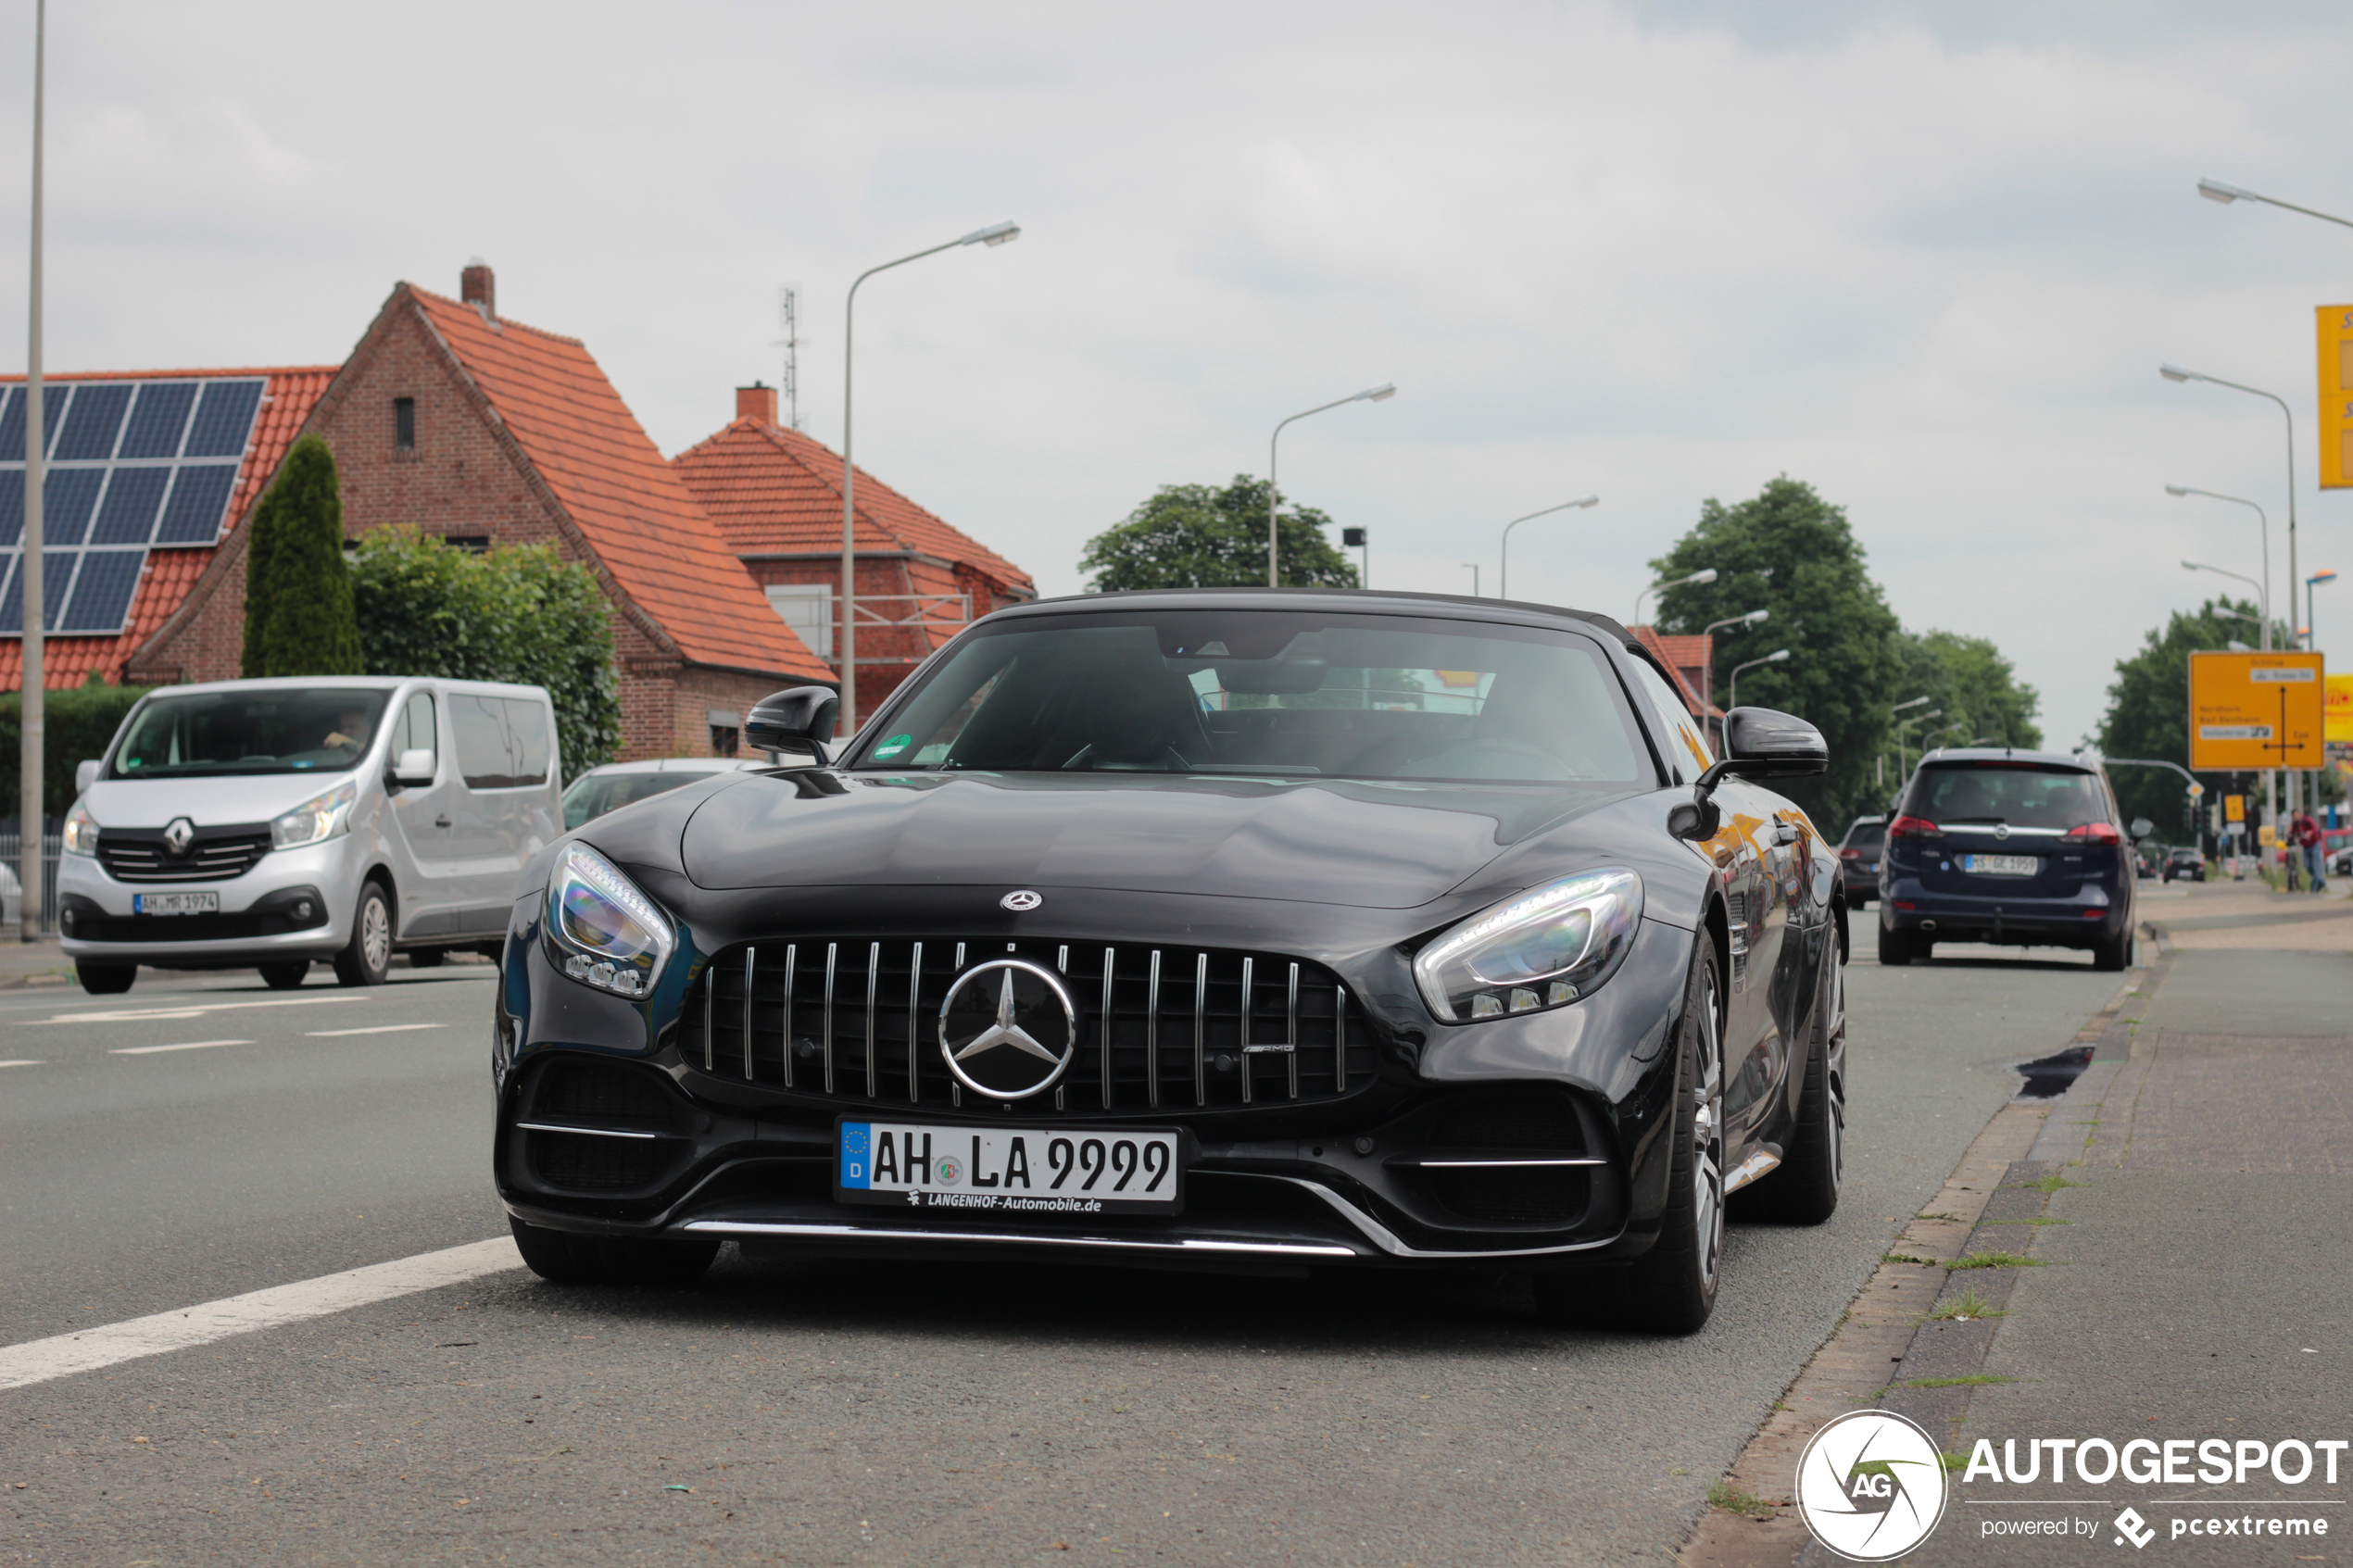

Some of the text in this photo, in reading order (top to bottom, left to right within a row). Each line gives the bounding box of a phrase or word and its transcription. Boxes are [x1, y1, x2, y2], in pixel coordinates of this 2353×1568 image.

[143, 896, 157, 909] AH
[185, 894, 214, 909] 1974
[850, 1162, 862, 1177] D
[874, 1131, 931, 1185] AH
[972, 1135, 1030, 1188] LA
[1048, 1137, 1170, 1192] 9999
[927, 1193, 1102, 1212] LANGENHOF-Automobile.de
